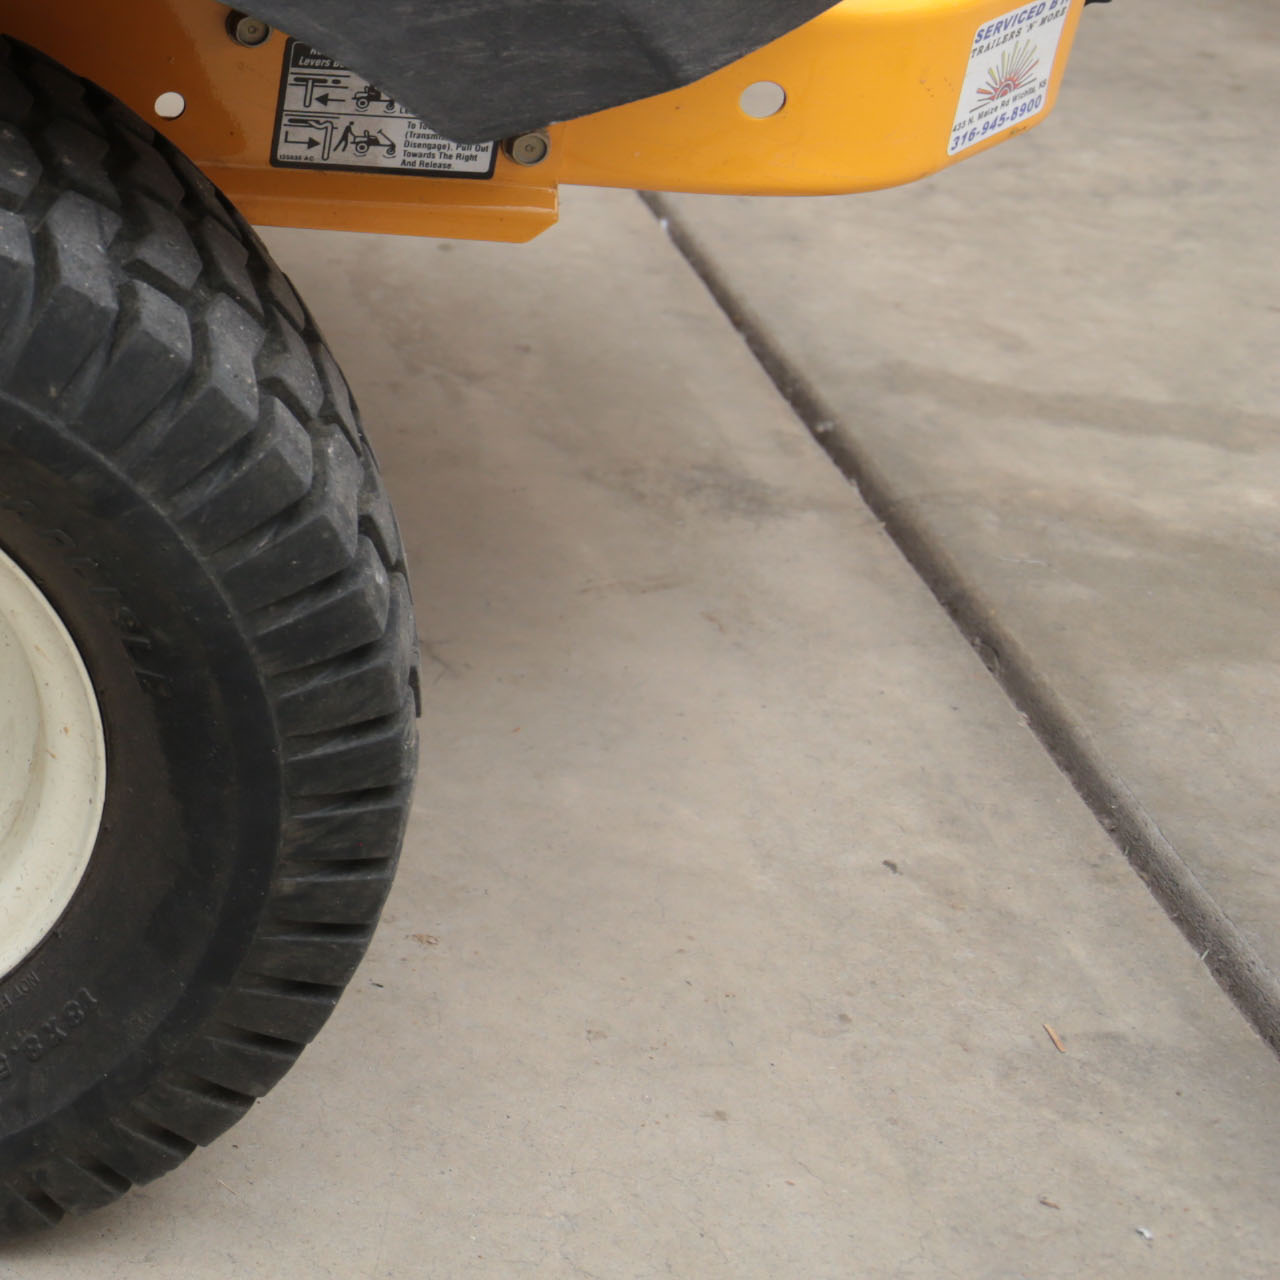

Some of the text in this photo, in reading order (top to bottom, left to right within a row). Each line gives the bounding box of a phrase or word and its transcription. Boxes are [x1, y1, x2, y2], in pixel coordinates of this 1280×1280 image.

[974, 2, 1046, 44] SERVICED
[971, 27, 1022, 58] TRAILERS
[1039, 6, 1067, 27] MORE
[298, 56, 331, 68] Levers
[977, 104, 999, 120] Maize
[1000, 99, 1010, 111] Rd
[950, 94, 1043, 151] 316-945-8900
[402, 150, 478, 163] Towards The Right
[455, 143, 472, 152] Pull
[474, 144, 489, 153] Out
[401, 159, 416, 168] And
